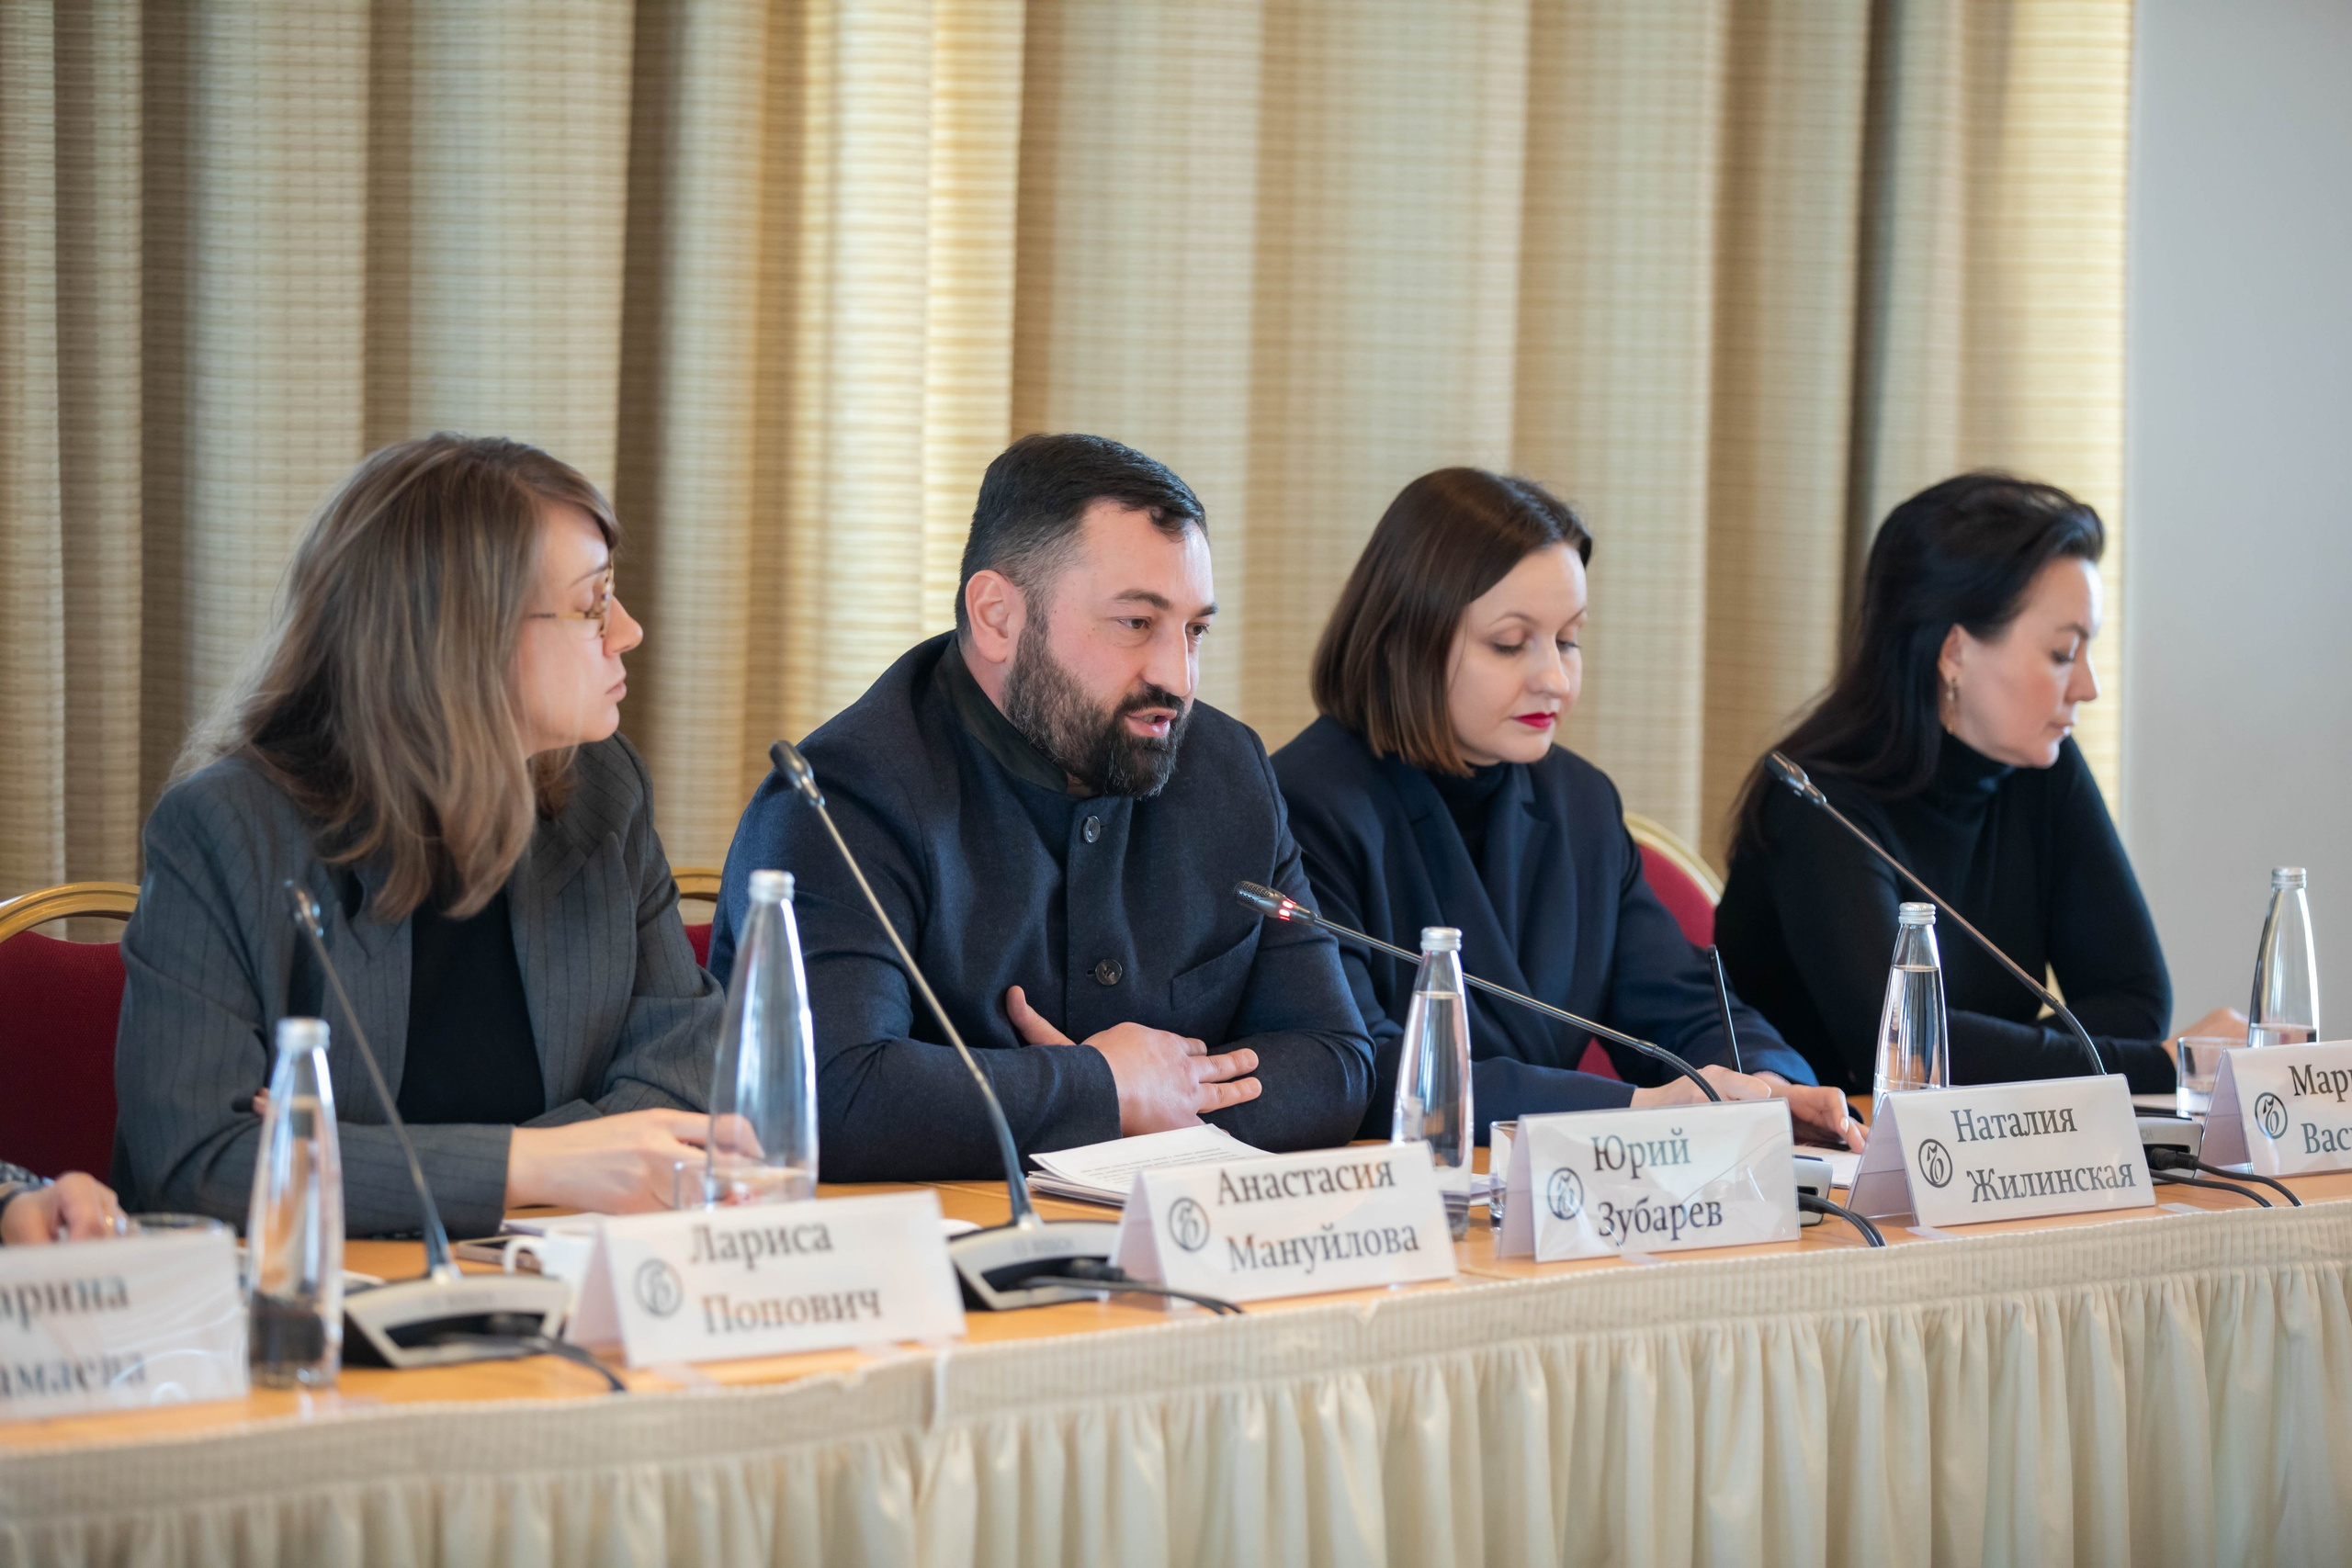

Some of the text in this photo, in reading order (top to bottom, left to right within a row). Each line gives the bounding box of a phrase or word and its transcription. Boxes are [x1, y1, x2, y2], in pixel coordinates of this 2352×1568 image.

[2288, 1064, 2352, 1103] Мар
[1950, 1108, 2078, 1143] Наталия
[2301, 1122, 2352, 1155] Вас
[1590, 1127, 1691, 1179] Юрий
[1216, 1159, 1397, 1207] Анастасия
[1966, 1163, 2137, 1203] Жилинская
[1597, 1196, 1724, 1246] Зубарев
[690, 1221, 833, 1272] Лариса
[1226, 1223, 1420, 1275] Мануйлова
[701, 1288, 883, 1335] Попович
